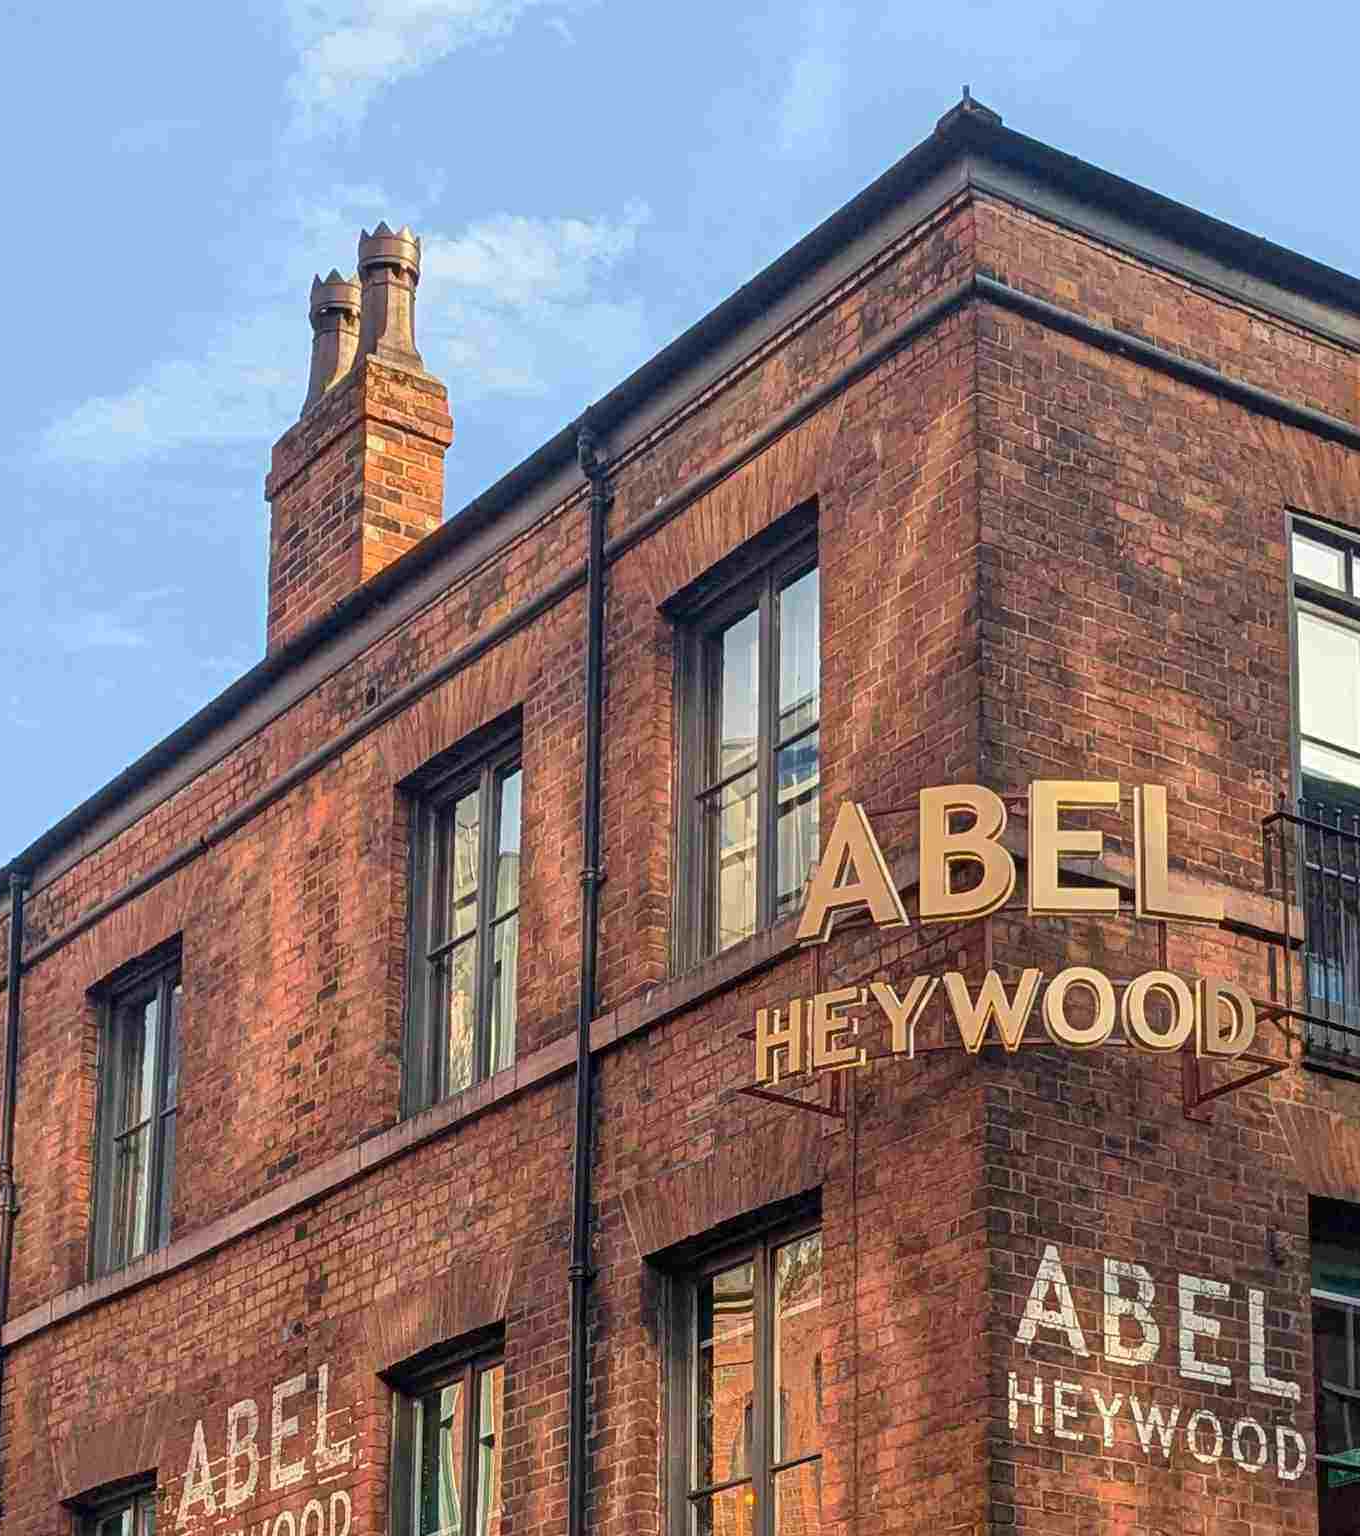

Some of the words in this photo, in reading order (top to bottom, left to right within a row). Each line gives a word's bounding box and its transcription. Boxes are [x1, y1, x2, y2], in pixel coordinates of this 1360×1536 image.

[795, 780, 1225, 946] ABEL
[754, 967, 1256, 1087] HEYWOOD
[1014, 1245, 1301, 1402] ABEL
[175, 1363, 352, 1529] ABEL
[1007, 1372, 1307, 1481] HEYWOOD
